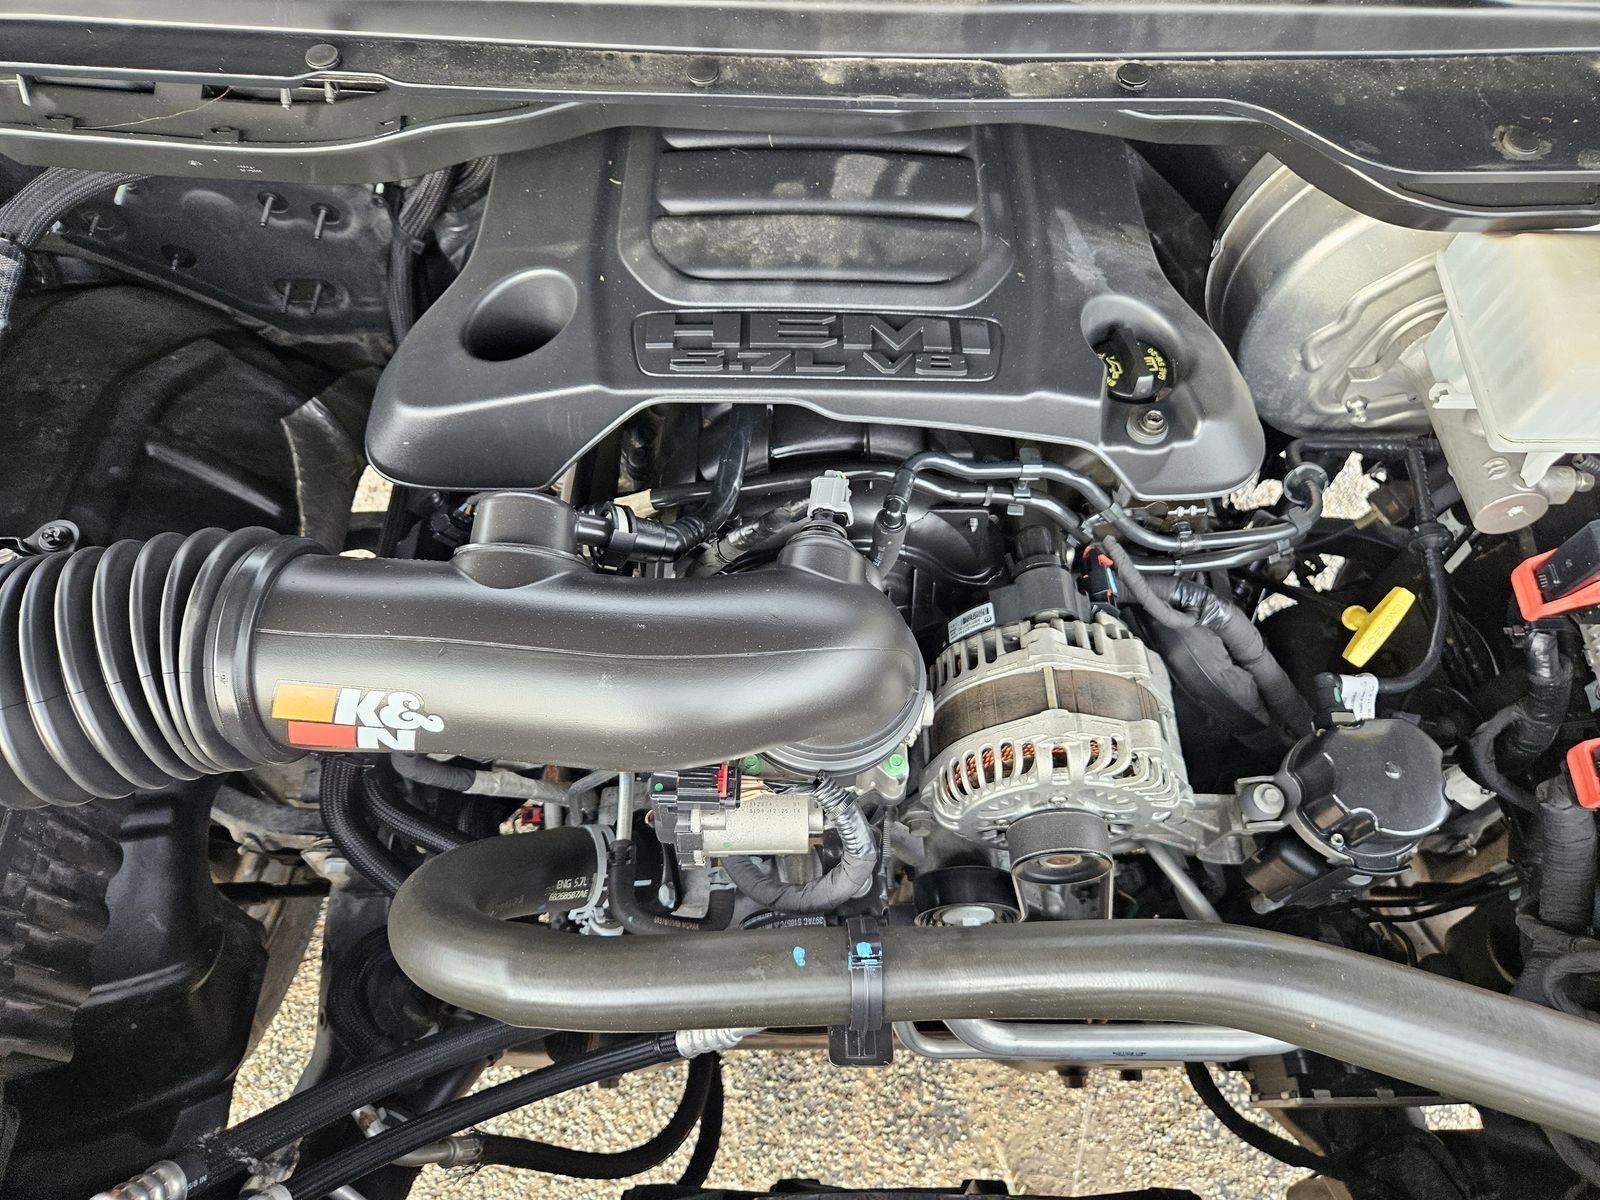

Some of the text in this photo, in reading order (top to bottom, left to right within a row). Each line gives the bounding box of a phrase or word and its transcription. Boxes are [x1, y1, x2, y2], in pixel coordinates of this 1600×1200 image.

[645, 313, 991, 354] HEMI
[669, 349, 968, 376] 5.7L V8
[556, 878, 573, 890] ENG
